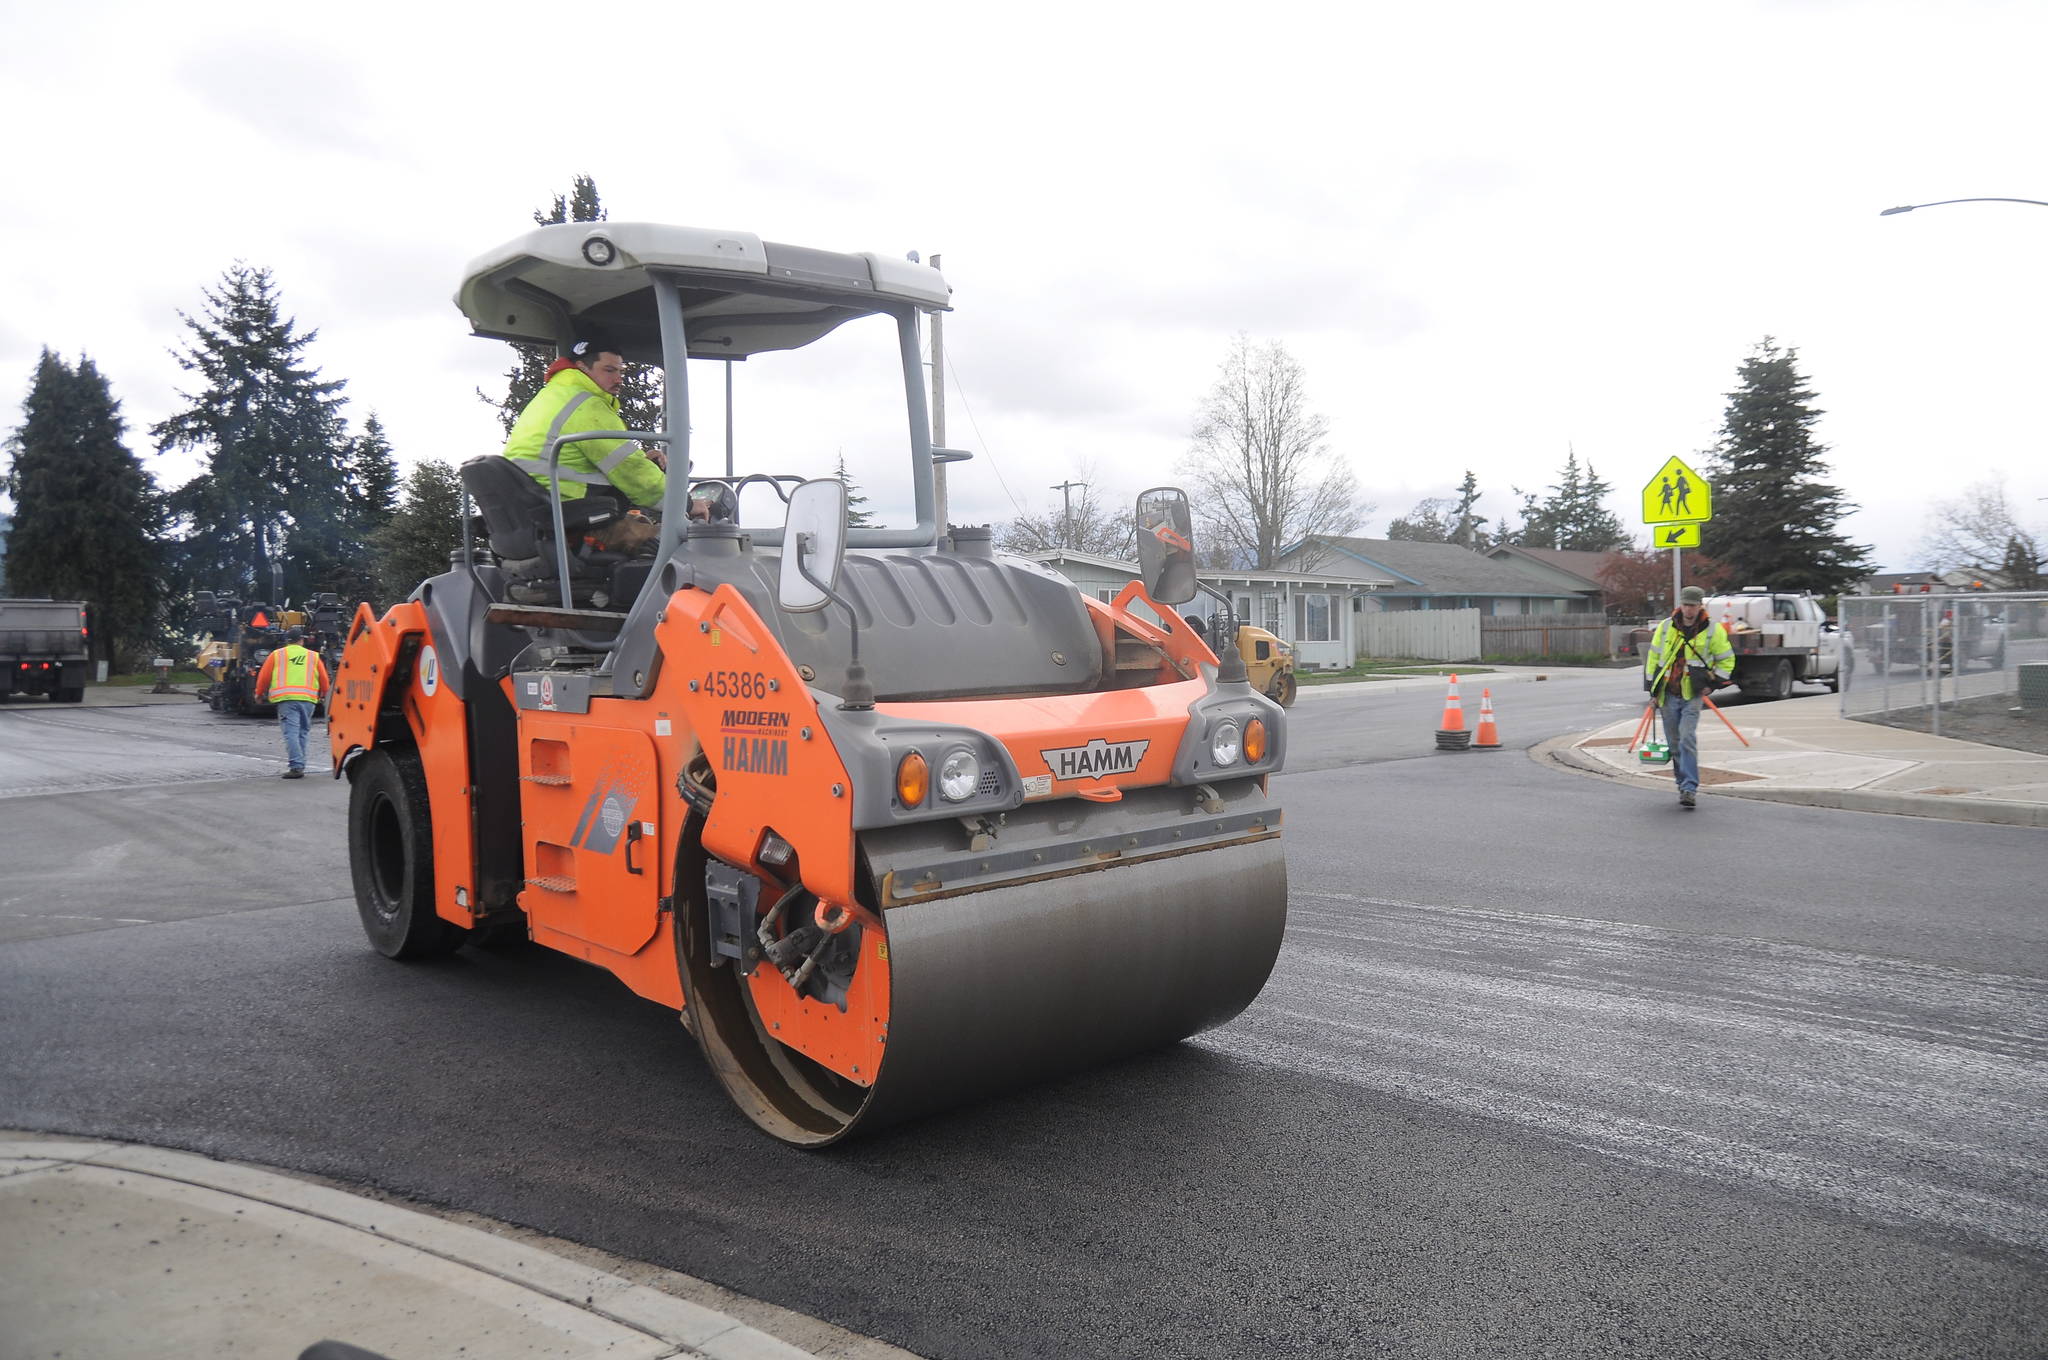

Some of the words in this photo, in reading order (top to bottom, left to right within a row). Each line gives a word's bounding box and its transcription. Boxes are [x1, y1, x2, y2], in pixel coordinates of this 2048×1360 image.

[703, 671, 766, 700] 45386
[720, 710, 790, 727] MODERN
[723, 736, 788, 776] HAMM
[1060, 746, 1133, 776] HAMM
